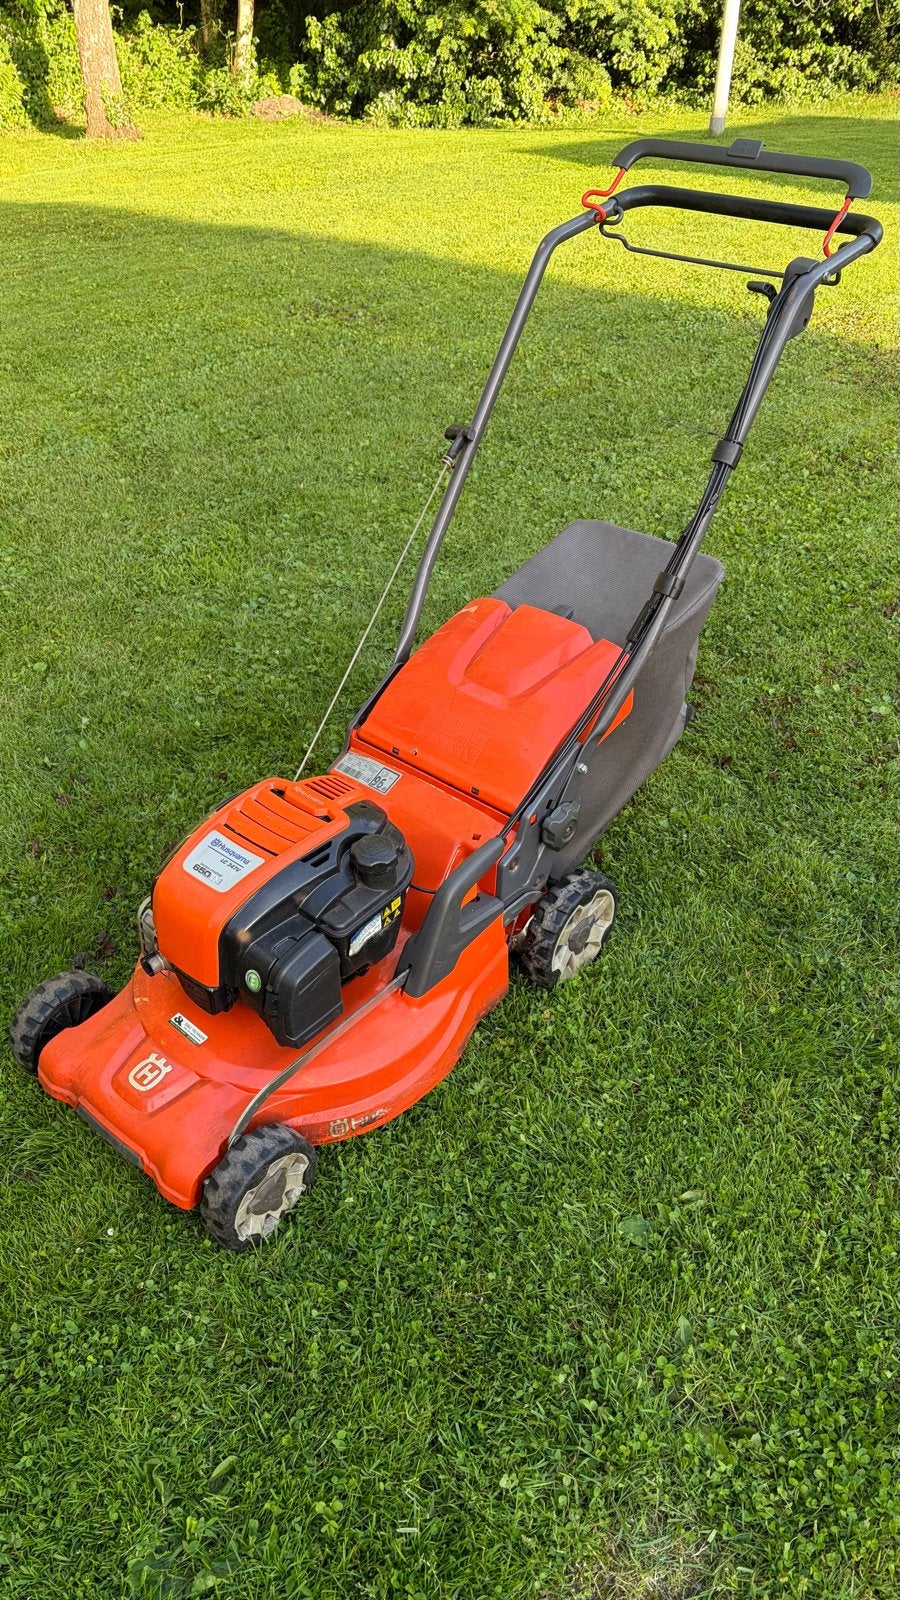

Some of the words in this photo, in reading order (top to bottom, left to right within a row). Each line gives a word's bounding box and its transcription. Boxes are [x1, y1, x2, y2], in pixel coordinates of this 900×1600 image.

[372, 776, 386, 788] 96
[218, 842, 250, 865] Husqvarna
[193, 864, 211, 878] 650
